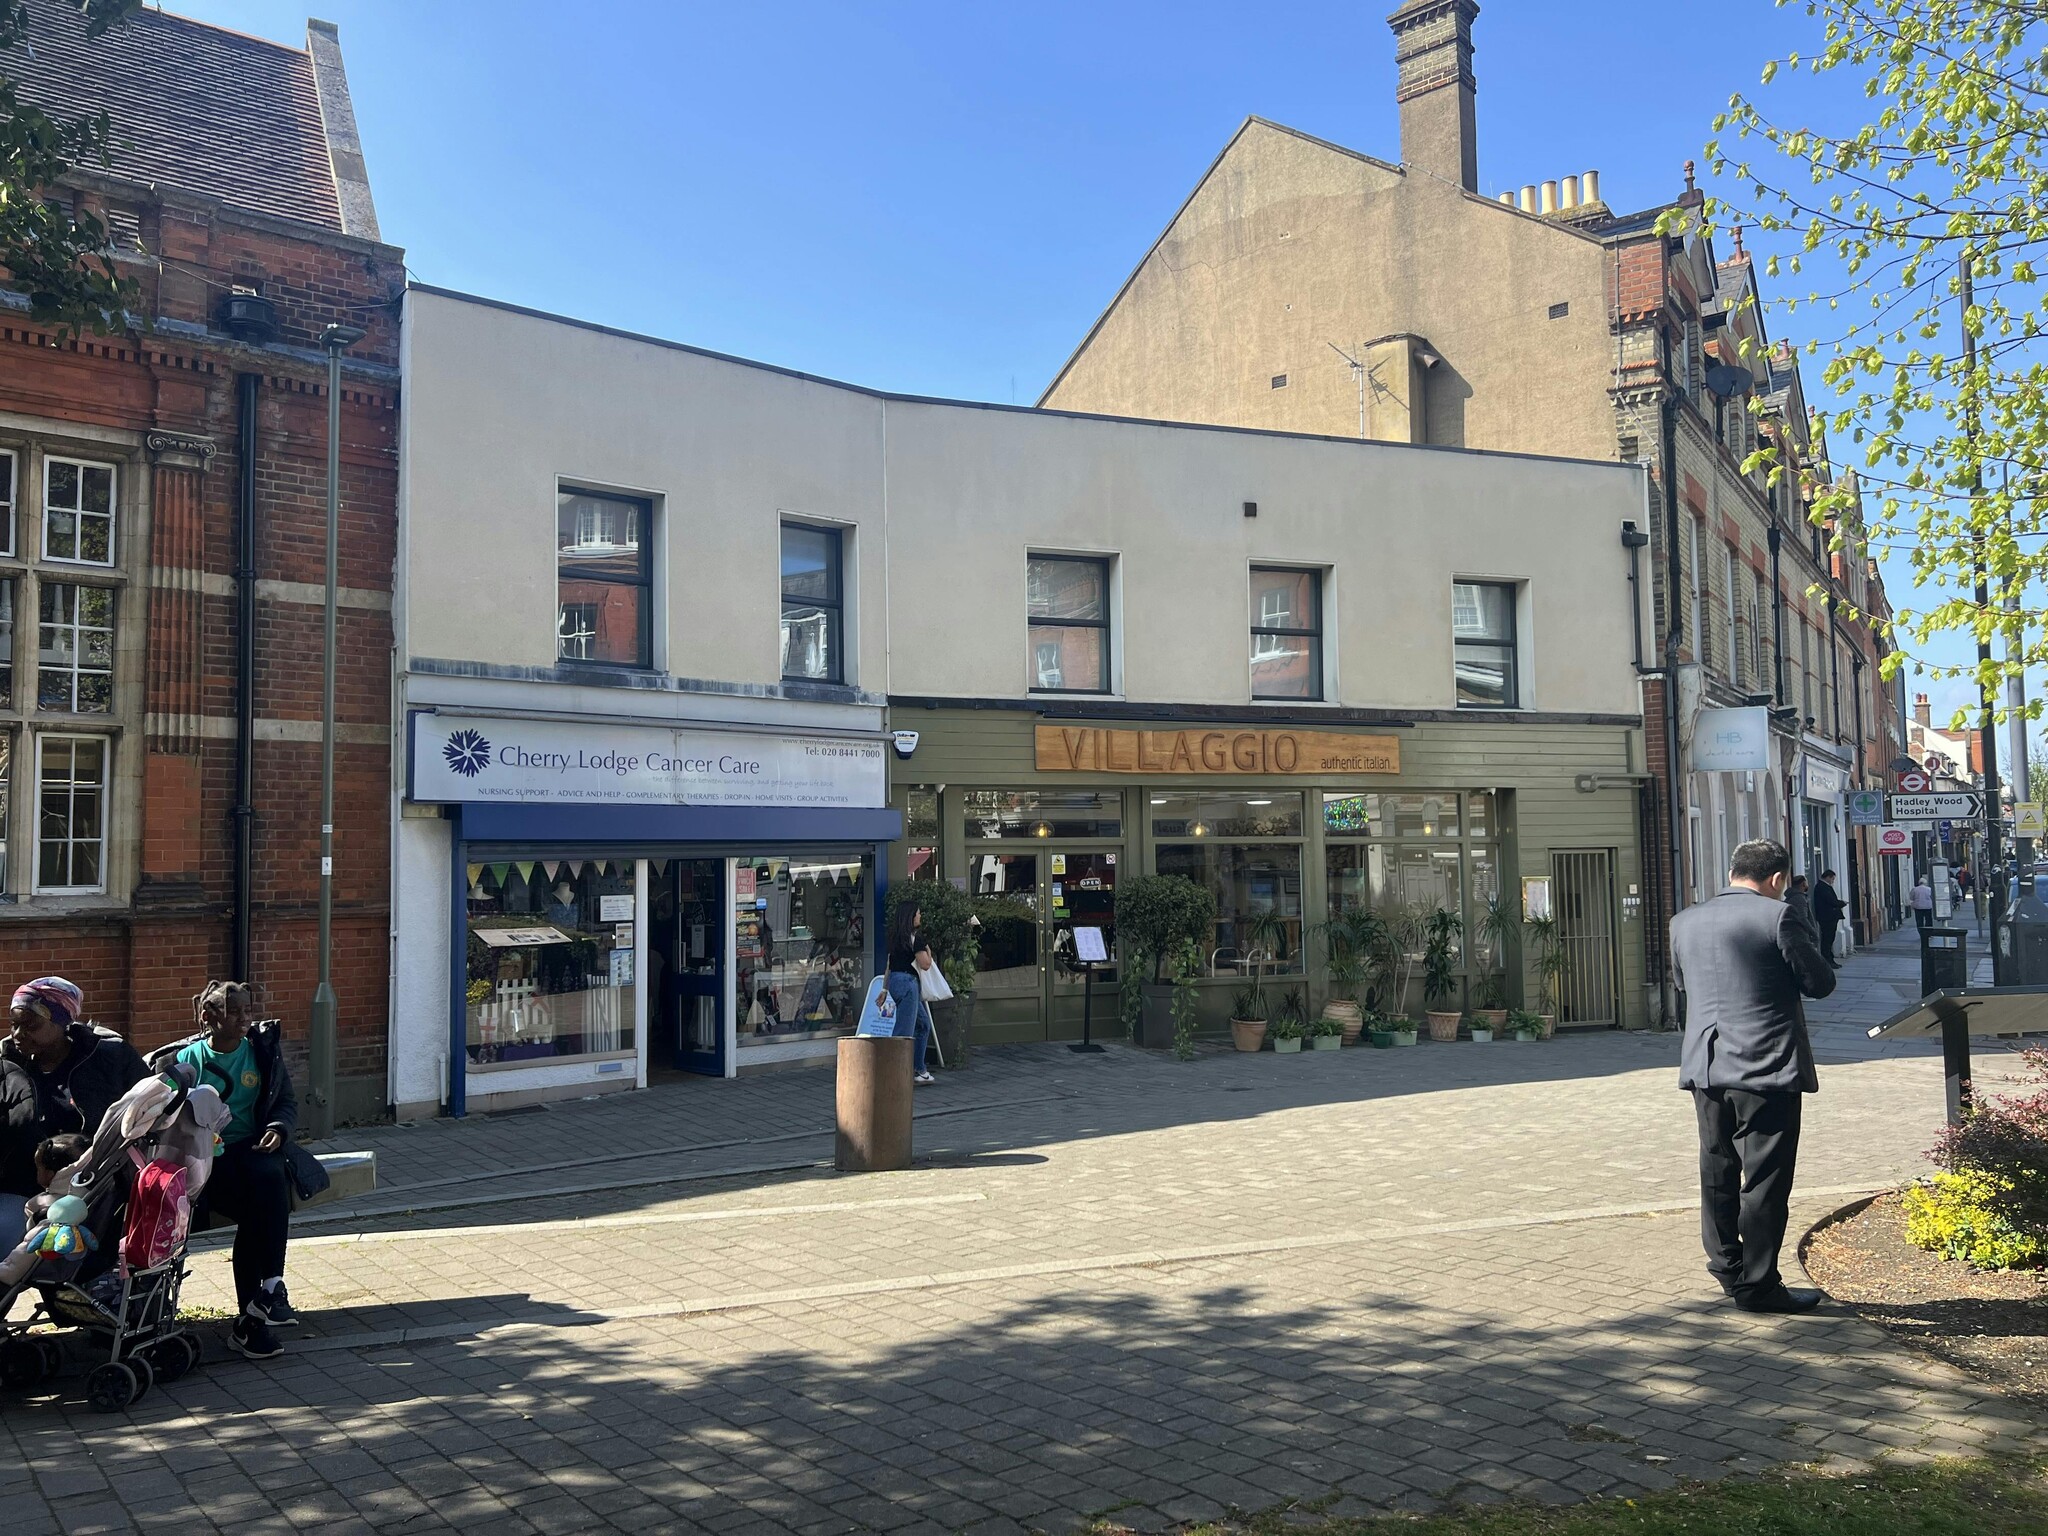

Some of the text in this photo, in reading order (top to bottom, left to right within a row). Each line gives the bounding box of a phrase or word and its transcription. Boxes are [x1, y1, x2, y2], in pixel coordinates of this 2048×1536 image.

[1716, 732, 1743, 744] HB
[805, 746, 881, 759] Tel: 020 8441 7000
[1061, 728, 1298, 774] VILLAGGIO
[499, 746, 760, 776] Cherry Lodge Cancer Care
[1320, 755, 1390, 770] authentic italian
[478, 788, 514, 796] NURSING
[515, 788, 550, 797] SUPPORT
[557, 790, 584, 798] ADVICE
[585, 790, 602, 798] AND
[625, 791, 684, 799] COMPLEMENTARY
[686, 792, 720, 800] THERAPIES
[724, 793, 751, 801] DROP-IN
[755, 793, 774, 801] HOME
[774, 794, 793, 802] VISITS
[1895, 797, 1963, 807] Hadley Wood
[1896, 807, 1938, 815] Hospital
